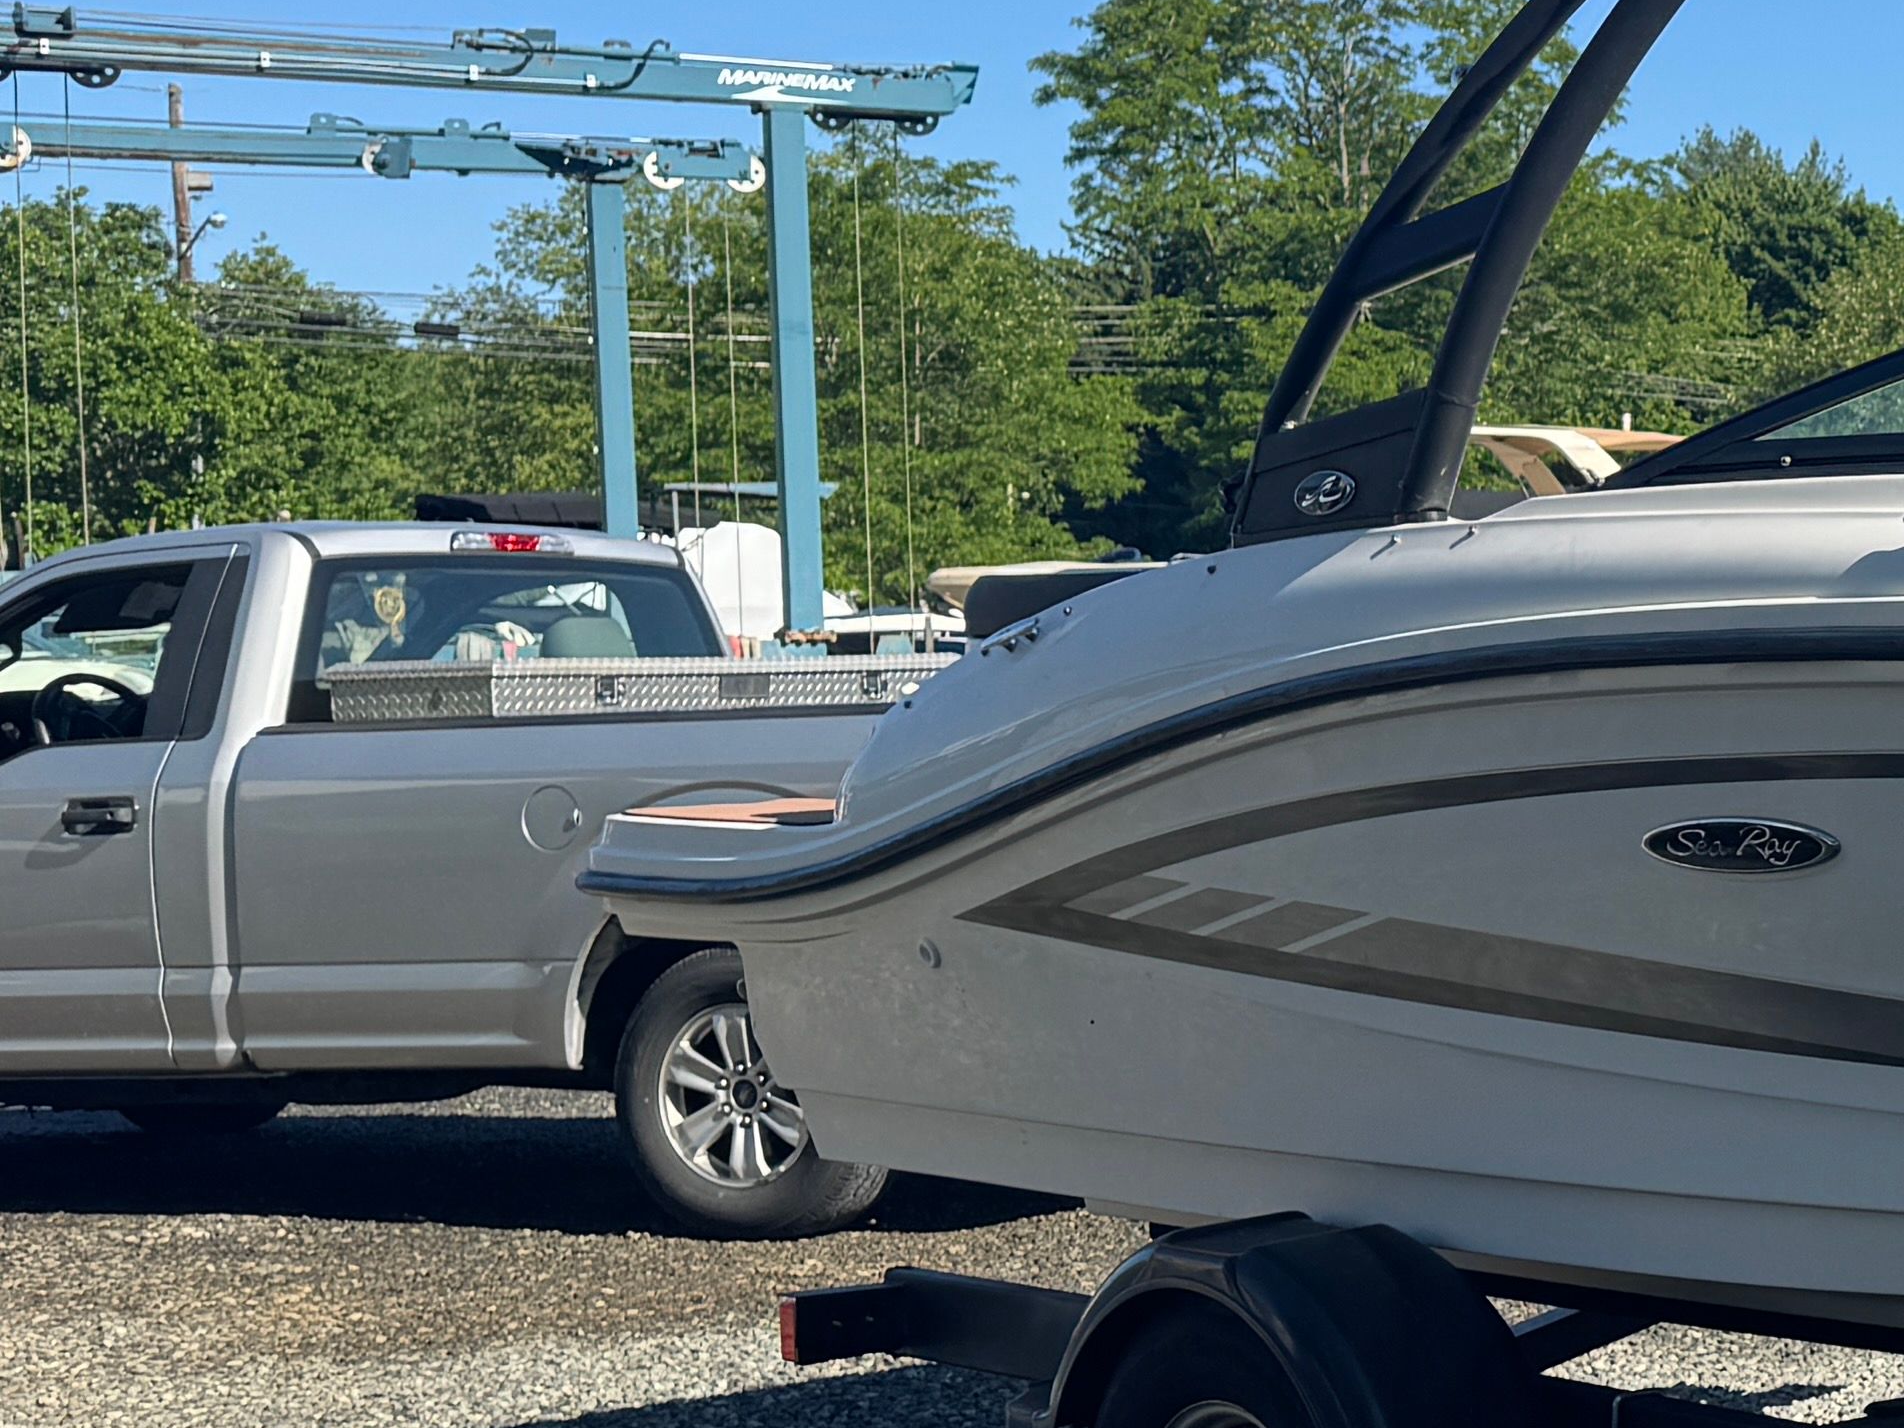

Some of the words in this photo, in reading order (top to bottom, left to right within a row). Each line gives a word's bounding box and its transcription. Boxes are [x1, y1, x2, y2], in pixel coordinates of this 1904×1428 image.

[717, 68, 856, 92] MARINEMAX
[1666, 828, 1729, 857] Sea
[1735, 824, 1801, 866] Ray
